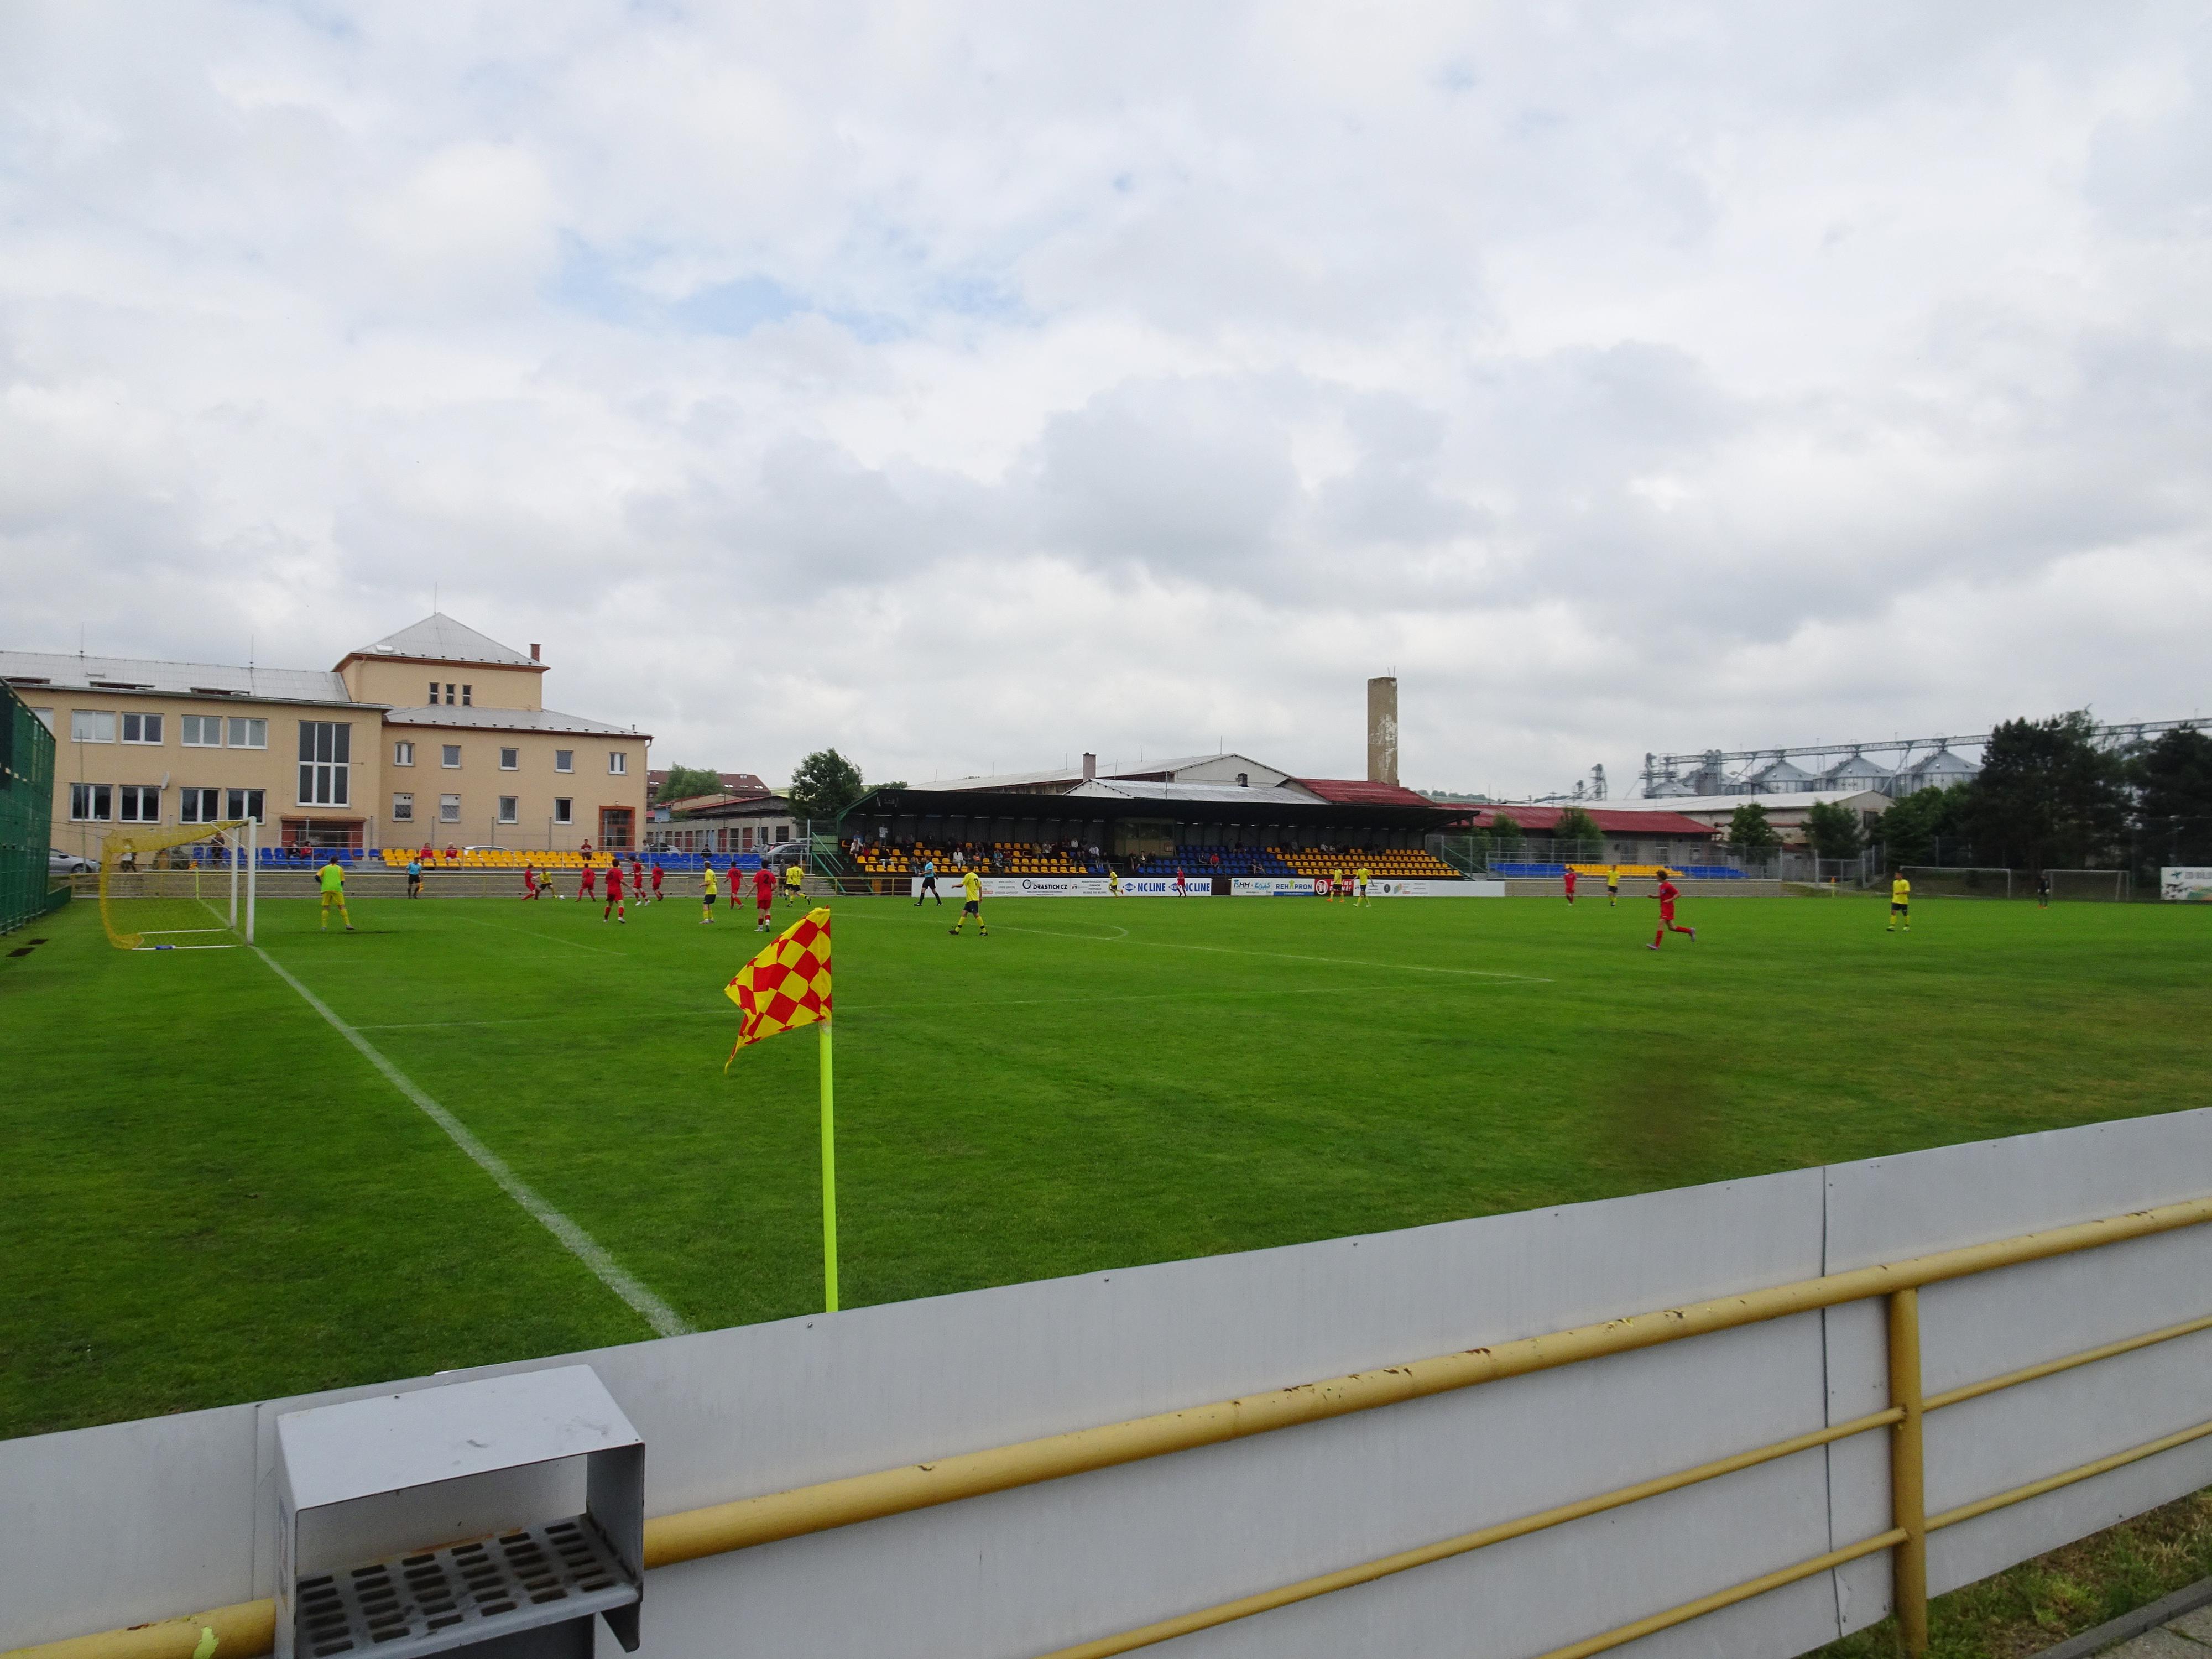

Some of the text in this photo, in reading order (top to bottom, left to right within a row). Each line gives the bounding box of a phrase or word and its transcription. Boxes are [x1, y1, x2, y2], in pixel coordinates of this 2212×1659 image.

[763, 874, 769, 884] 2
[1138, 883, 1166, 891] NC LINE
[1194, 883, 1210, 891] LINE
